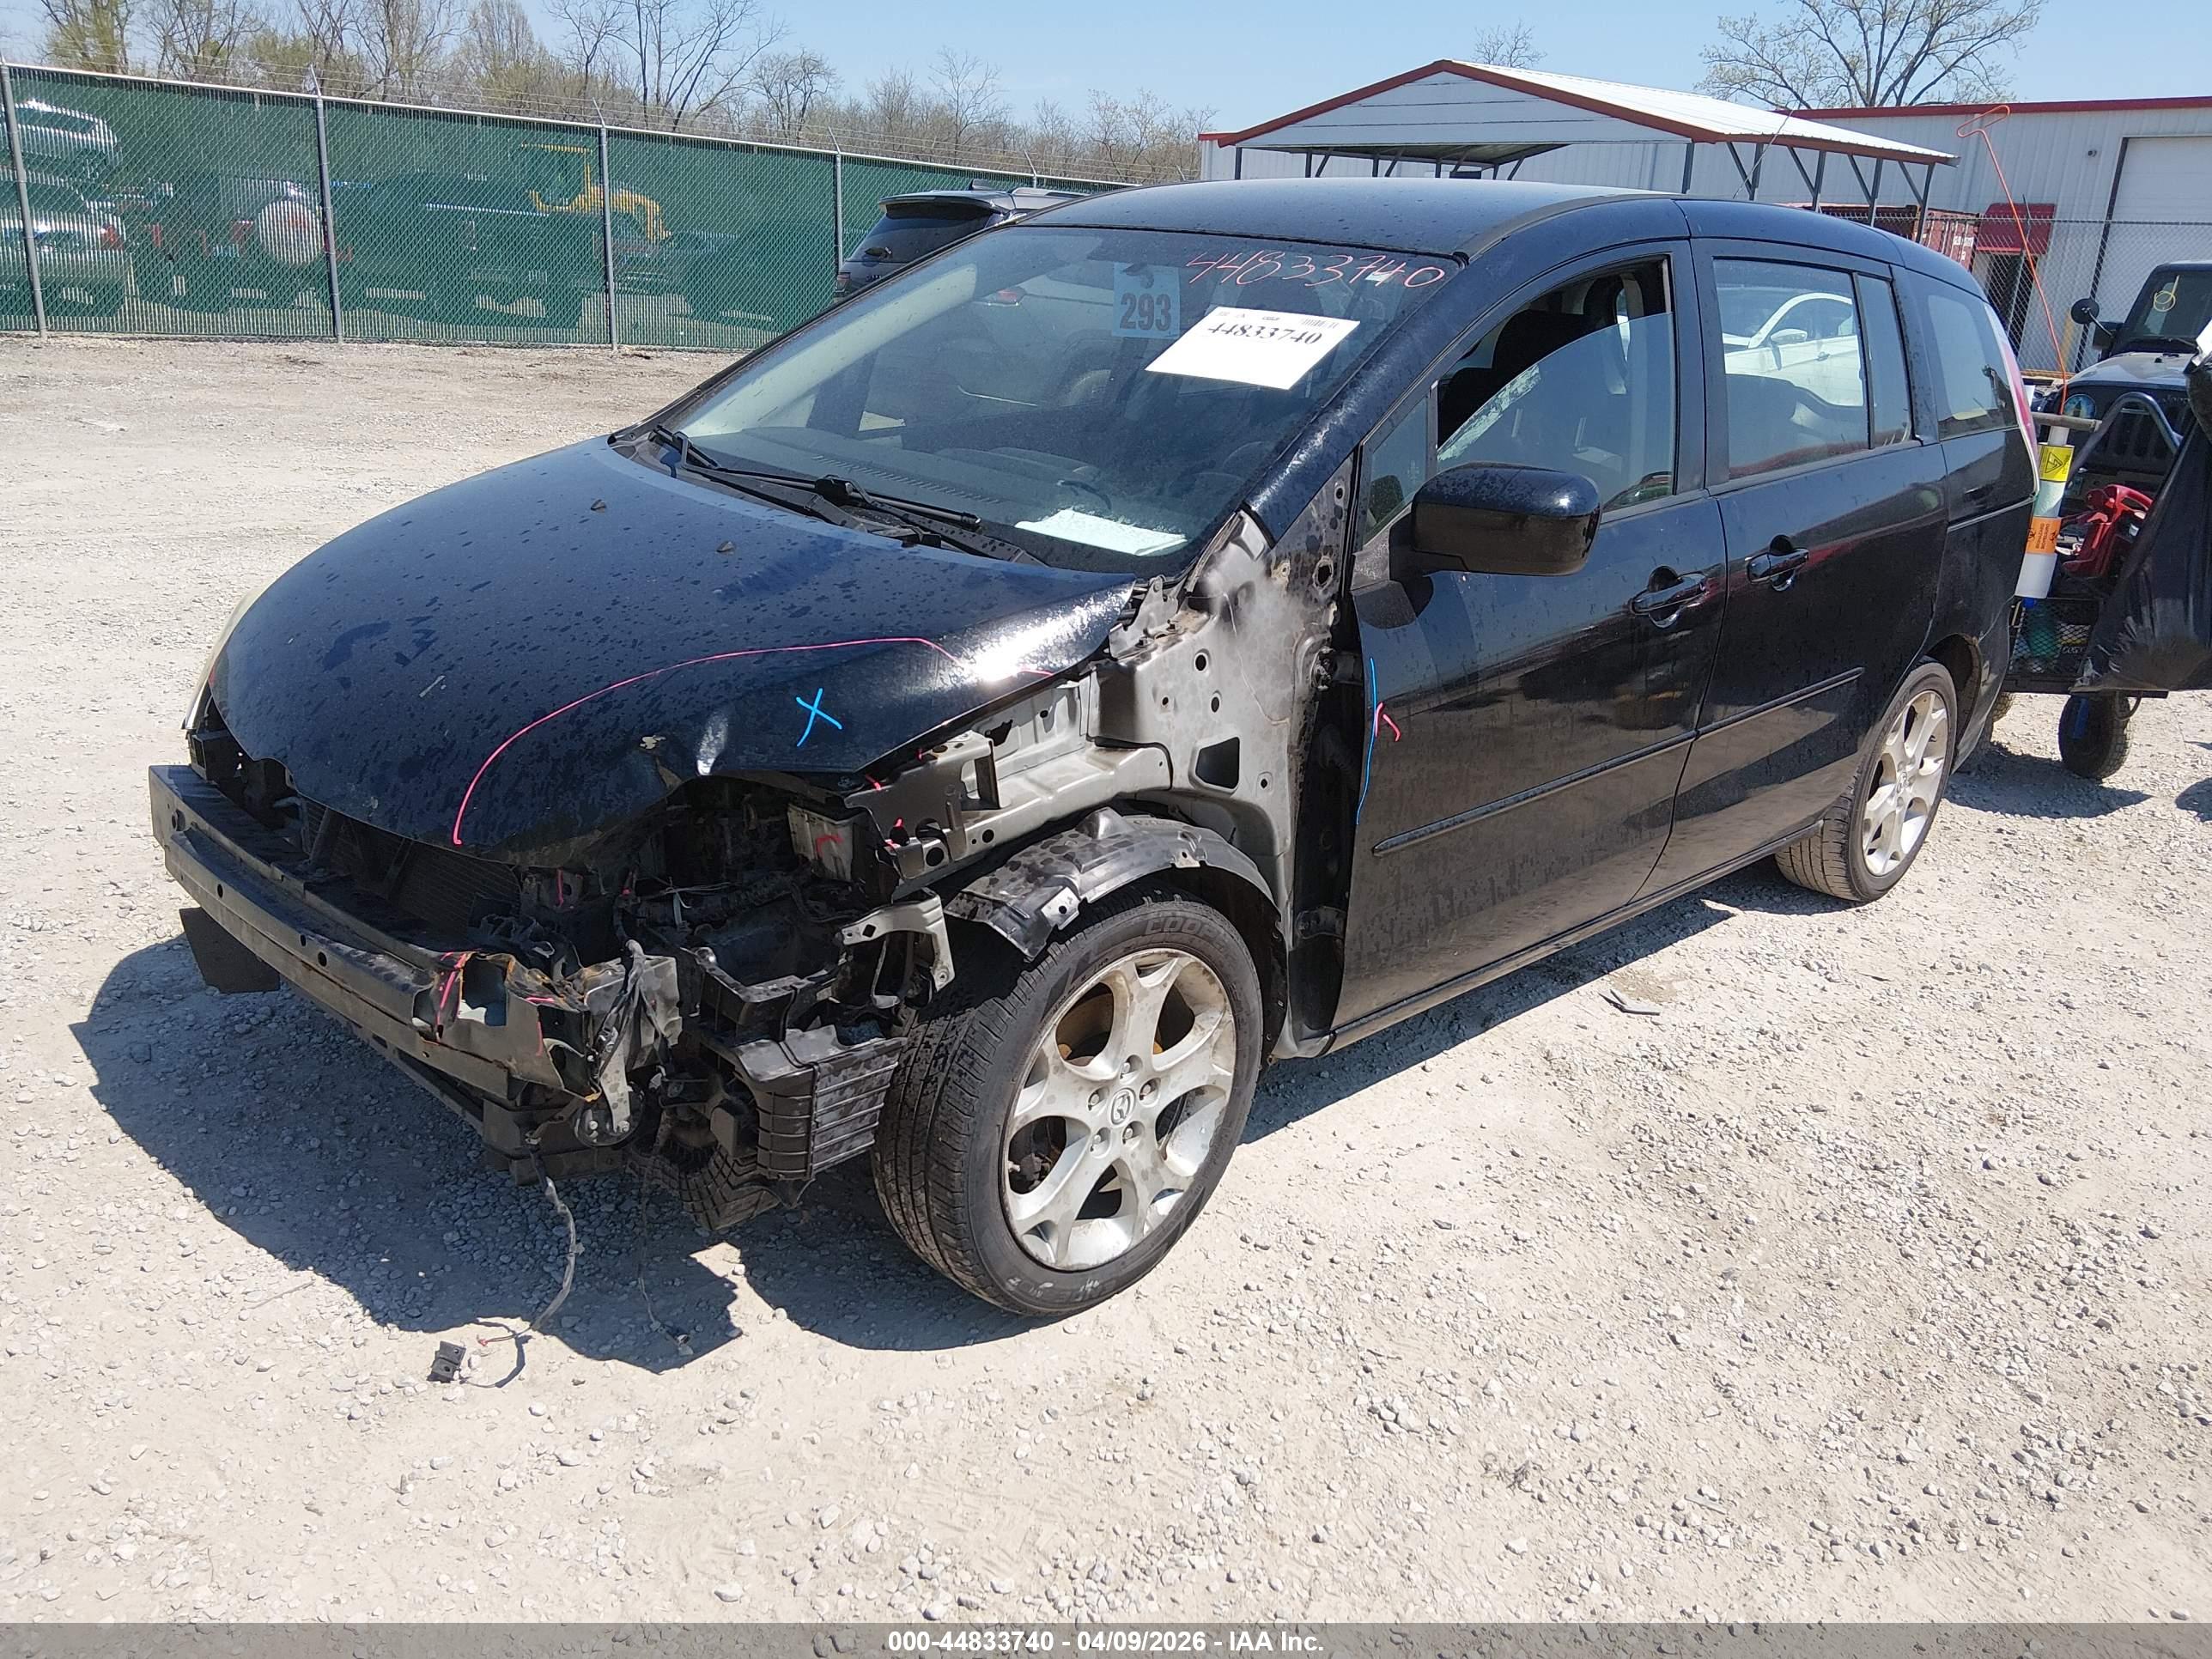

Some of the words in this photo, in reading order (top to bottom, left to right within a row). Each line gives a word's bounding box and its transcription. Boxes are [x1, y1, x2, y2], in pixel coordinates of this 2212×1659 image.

[1185, 250, 1446, 288] 44833740
[1119, 292, 1172, 331] 293
[1207, 322, 1323, 344] 44833740
